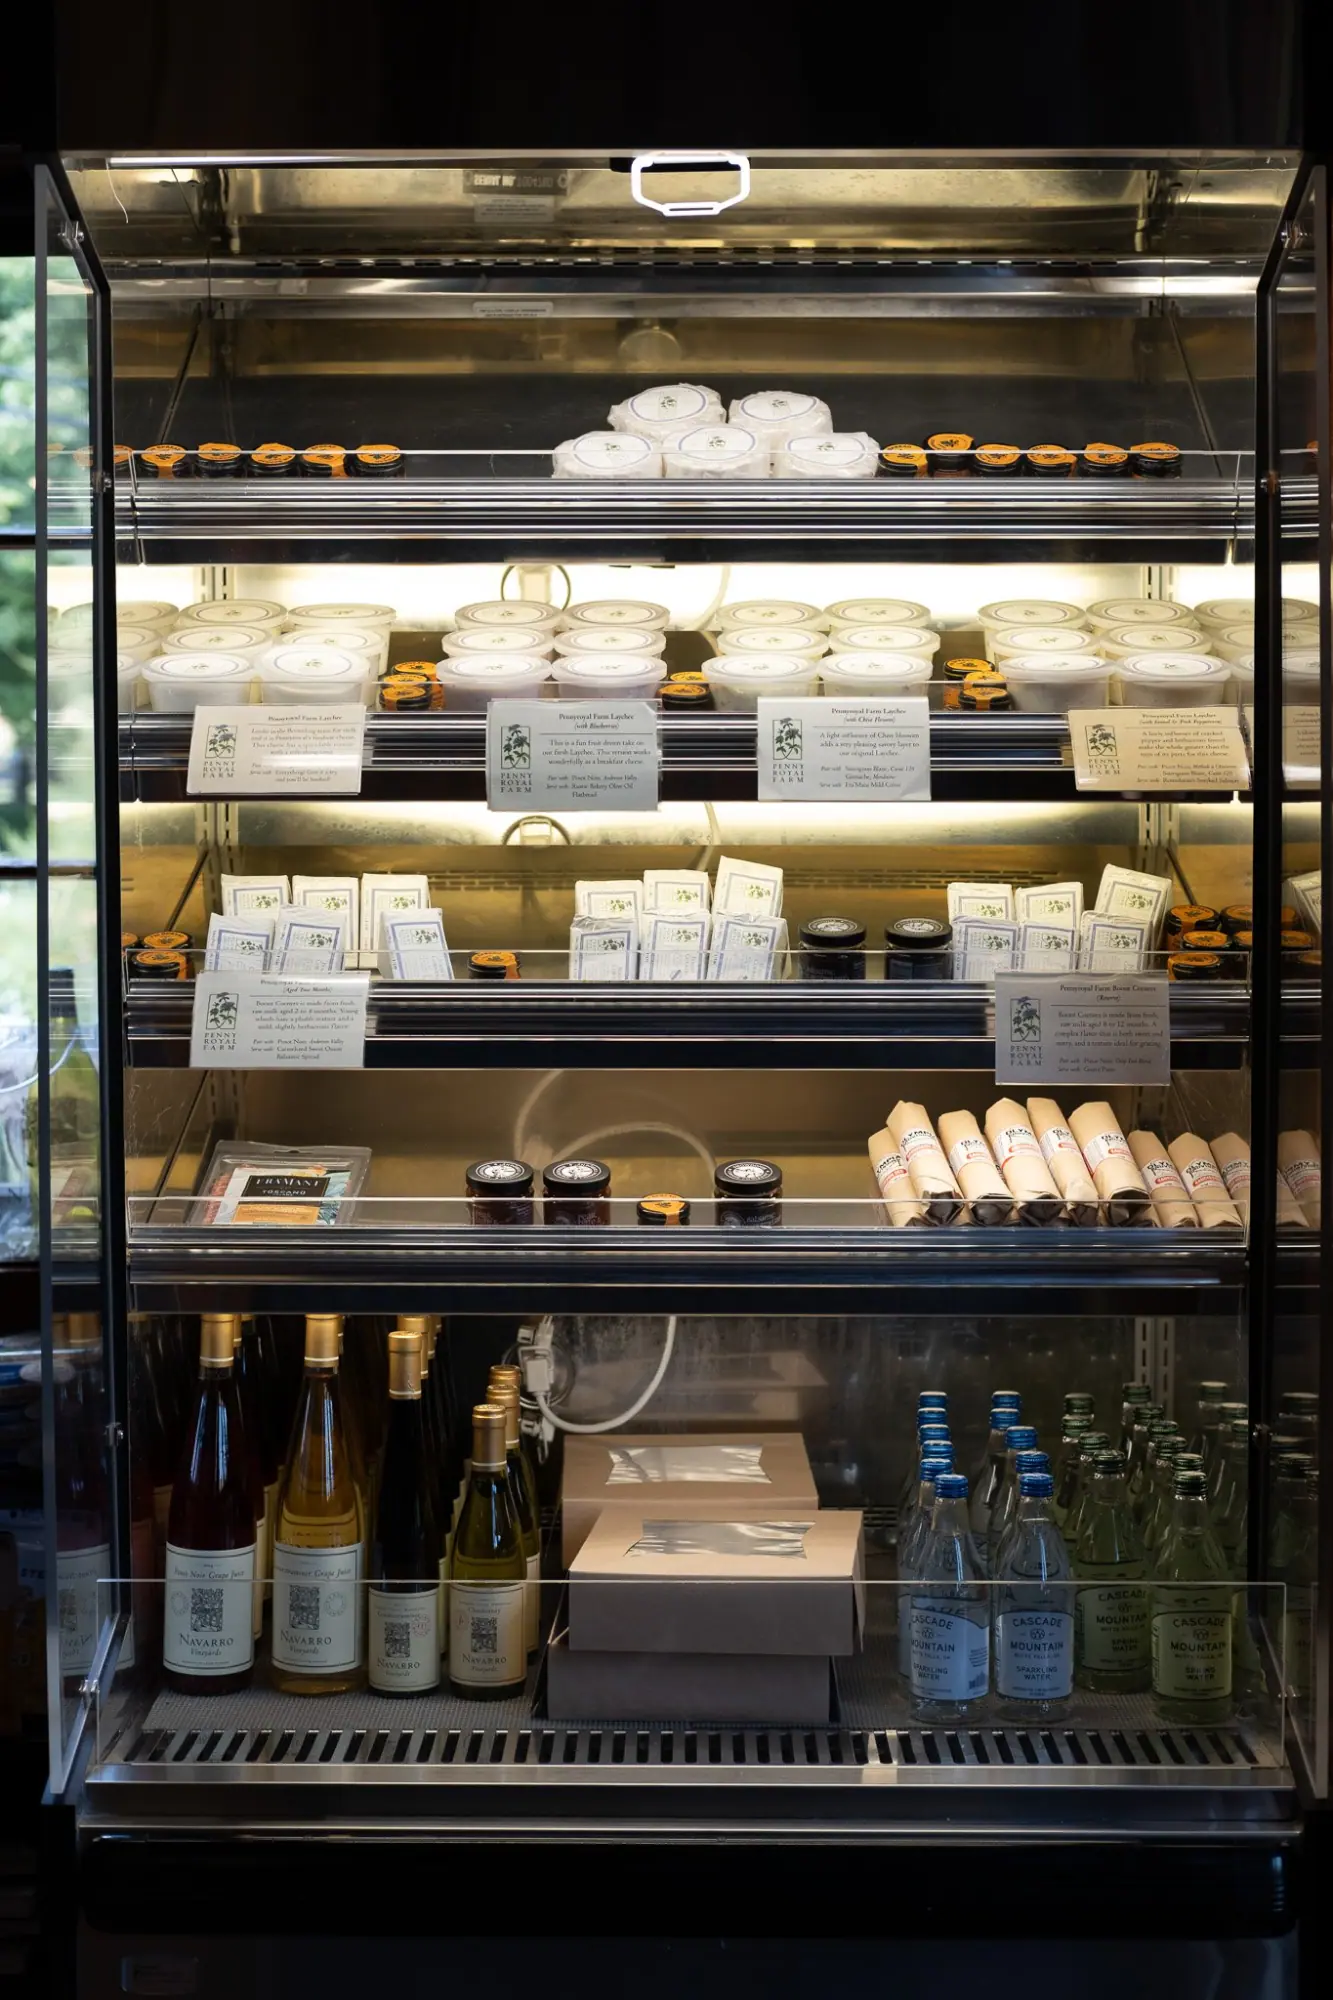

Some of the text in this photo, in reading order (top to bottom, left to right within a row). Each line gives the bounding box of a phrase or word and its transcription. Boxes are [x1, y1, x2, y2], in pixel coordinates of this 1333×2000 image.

[559, 713, 634, 721] Pennyroyal Farm Laychee
[190, 1570, 205, 1578] Noir
[208, 1571, 229, 1580] Grape
[314, 1569, 335, 1579] Grape
[1098, 1590, 1147, 1601] CASCADE
[911, 1615, 953, 1630] CASCADE
[1013, 1617, 1063, 1627] CASCADE
[1096, 1613, 1147, 1624] MOUNTAIN
[1173, 1617, 1225, 1627] CASCADE
[911, 1639, 955, 1652] MOUNTAIN
[1010, 1641, 1063, 1651] MOUNTAIN
[1171, 1642, 1226, 1652] MOUNTAIN
[191, 1648, 222, 1658] Vineyards
[914, 1662, 948, 1675] SPARKLING
[918, 1671, 940, 1680] WATER
